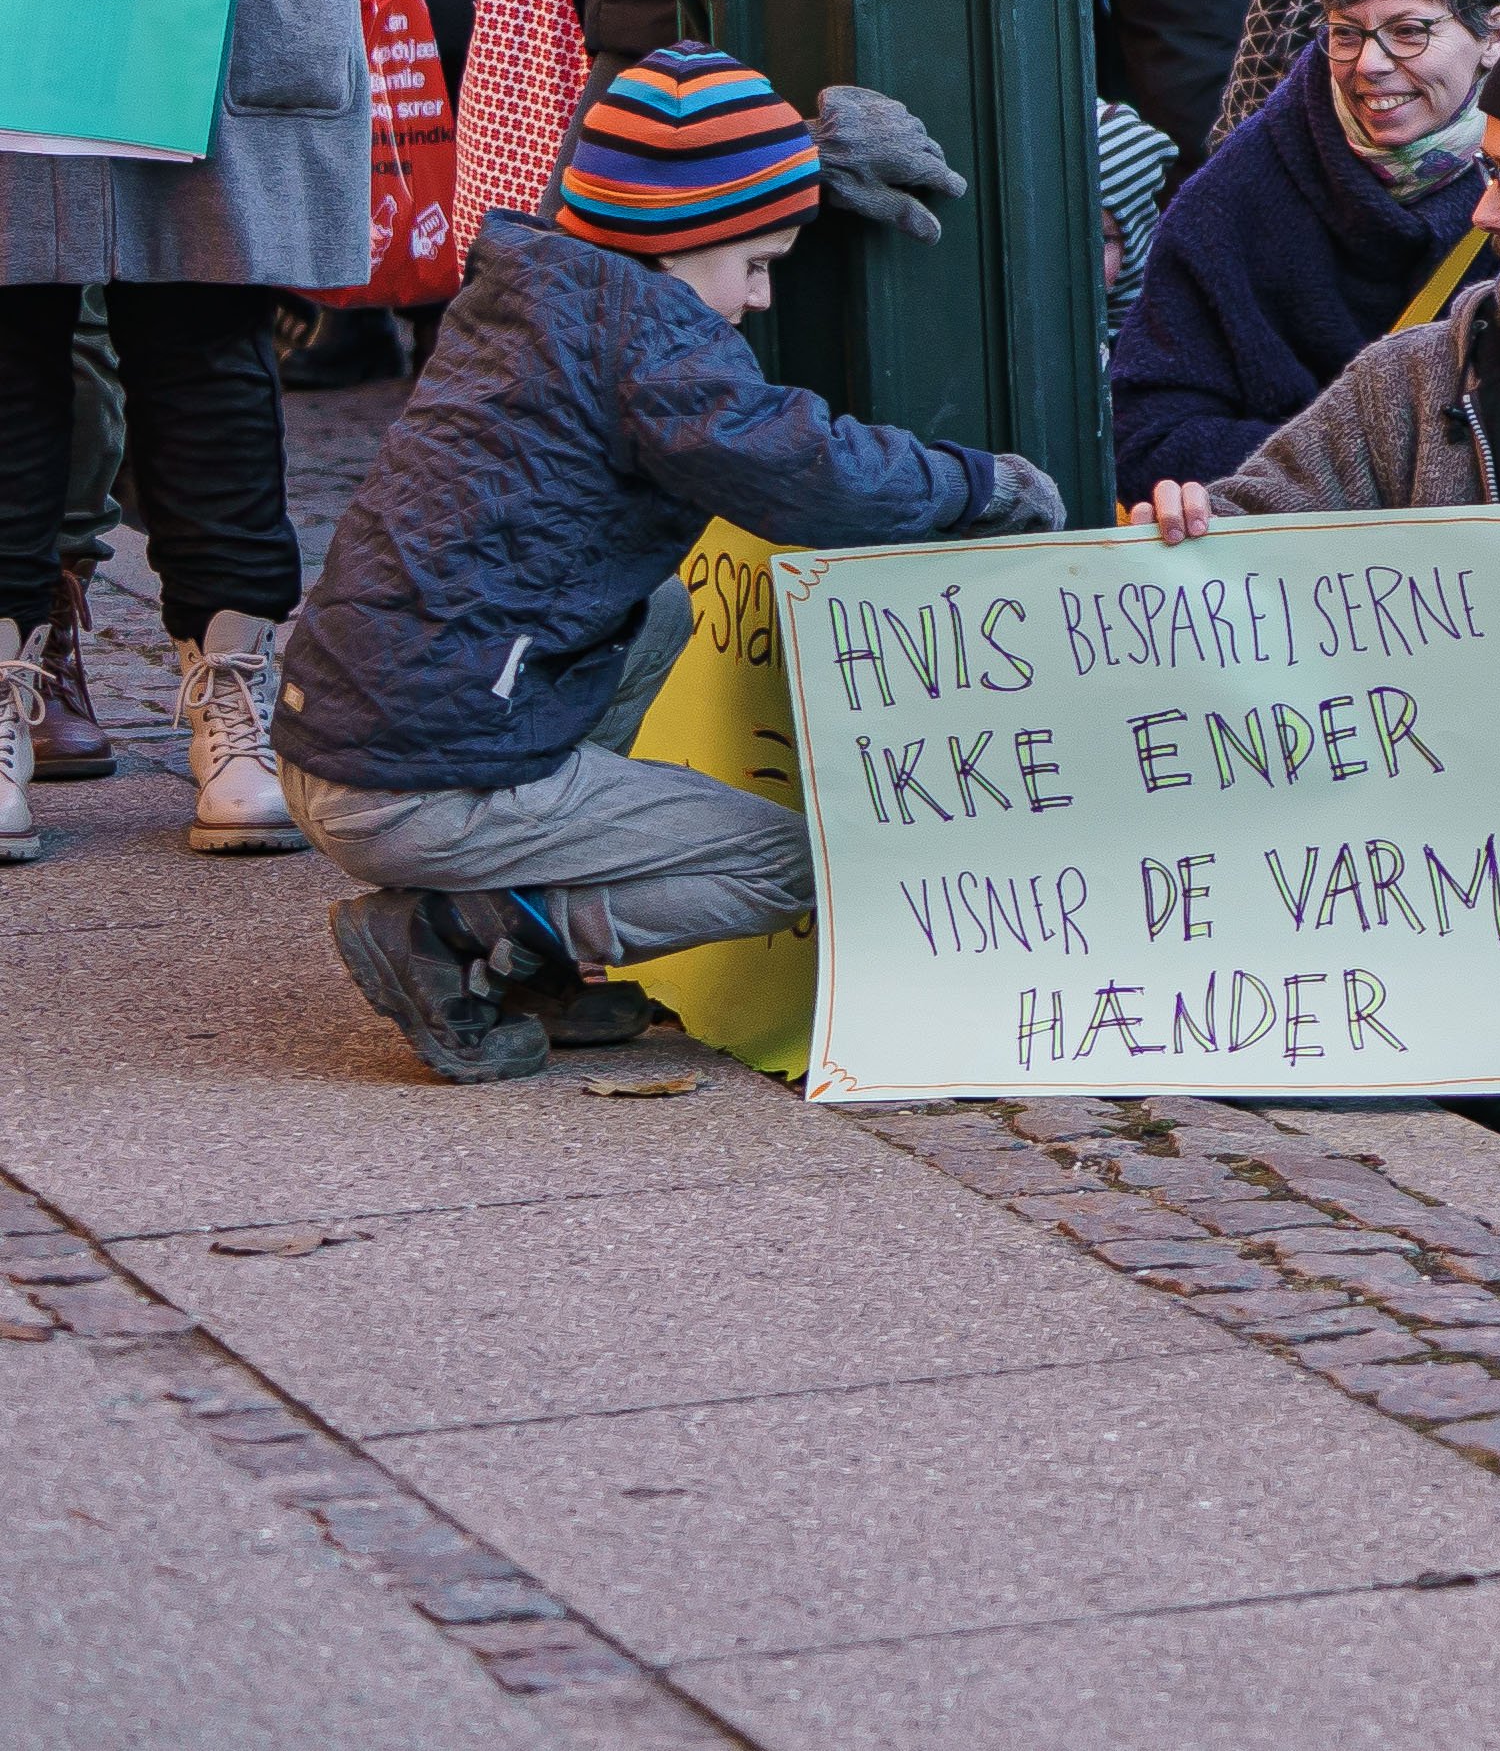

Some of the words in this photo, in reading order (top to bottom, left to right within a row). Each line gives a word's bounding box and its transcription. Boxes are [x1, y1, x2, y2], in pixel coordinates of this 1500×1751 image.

[827, 584, 1034, 712] HVIS
[1058, 565, 1485, 677] BESPARELSERNE
[853, 727, 1075, 827] IKKE
[1127, 686, 1445, 794] ENDER
[900, 865, 1091, 958] VISNER
[1140, 852, 1217, 944] DE
[1016, 968, 1409, 1069] HÆNDER
